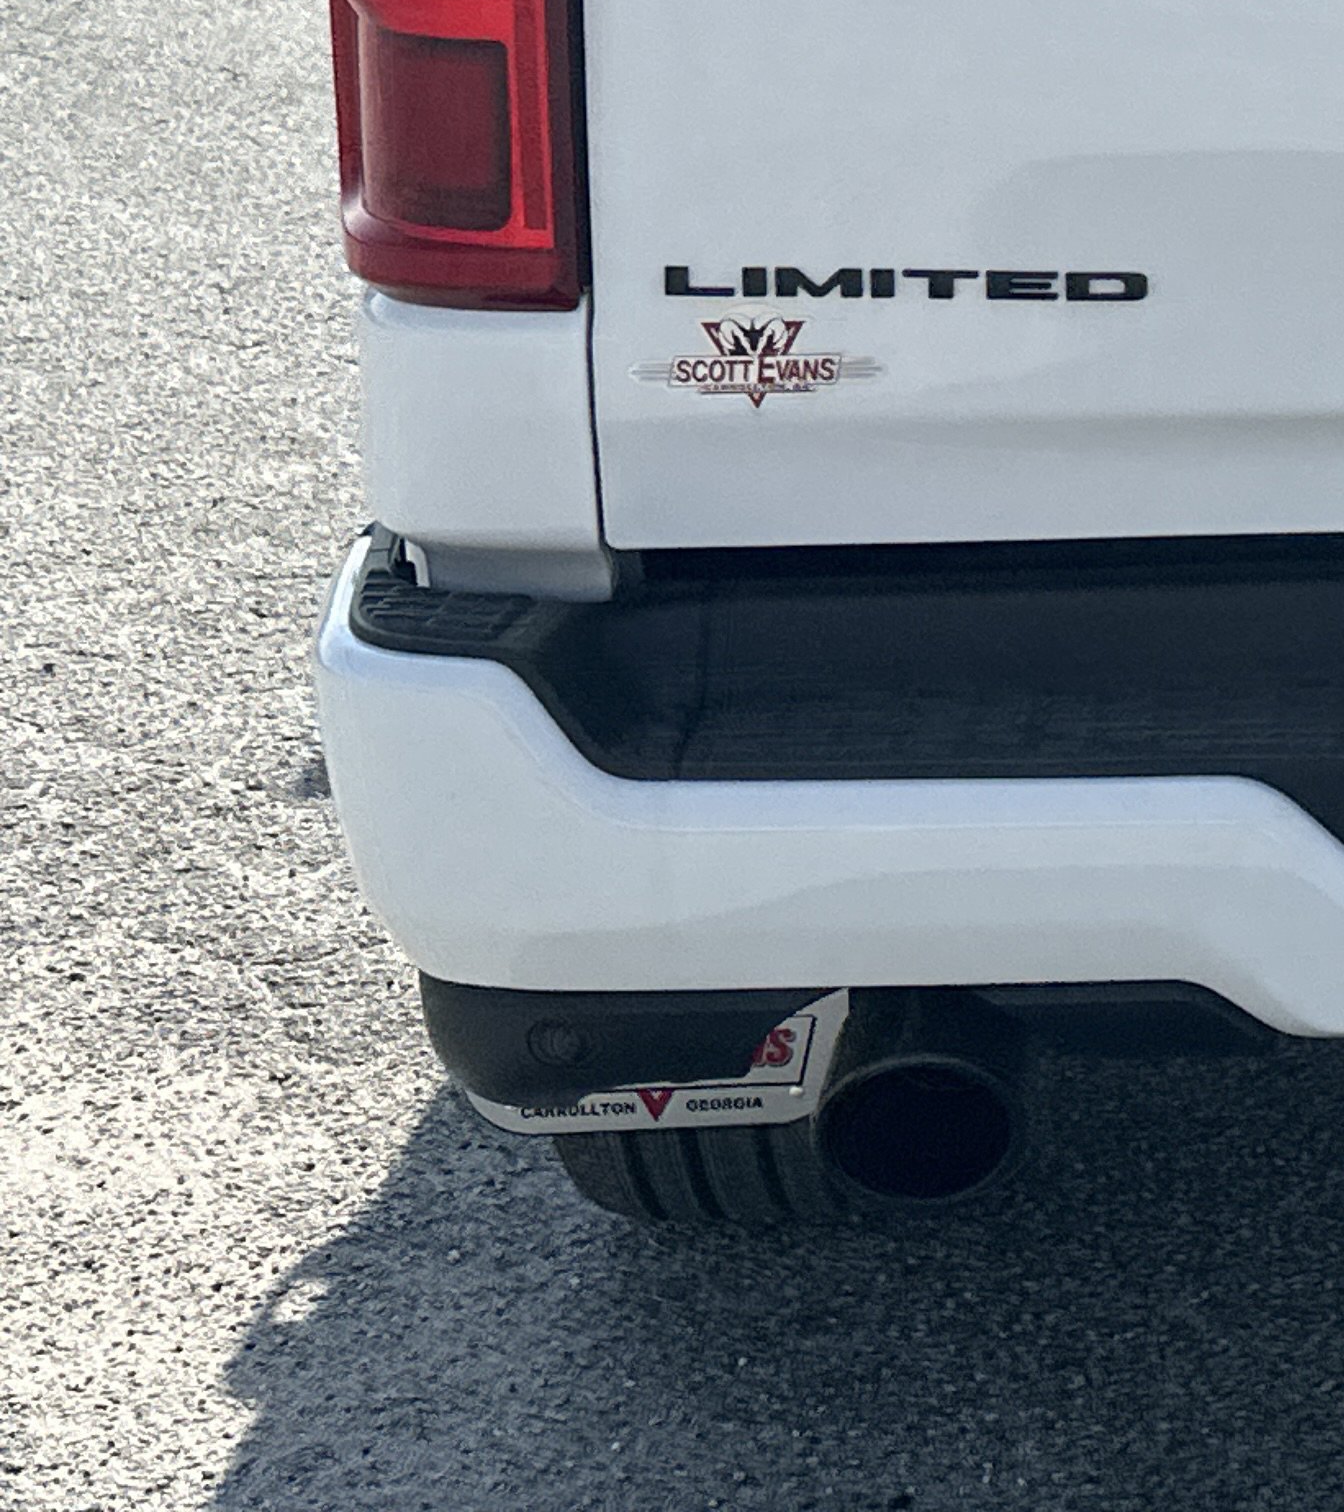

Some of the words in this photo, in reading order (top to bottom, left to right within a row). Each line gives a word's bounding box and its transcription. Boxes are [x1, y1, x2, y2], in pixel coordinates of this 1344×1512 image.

[664, 265, 1149, 302] LIMITED
[676, 359, 754, 382] SCOTT
[757, 355, 836, 383] EVANS
[685, 1097, 763, 1112] GEORGIA
